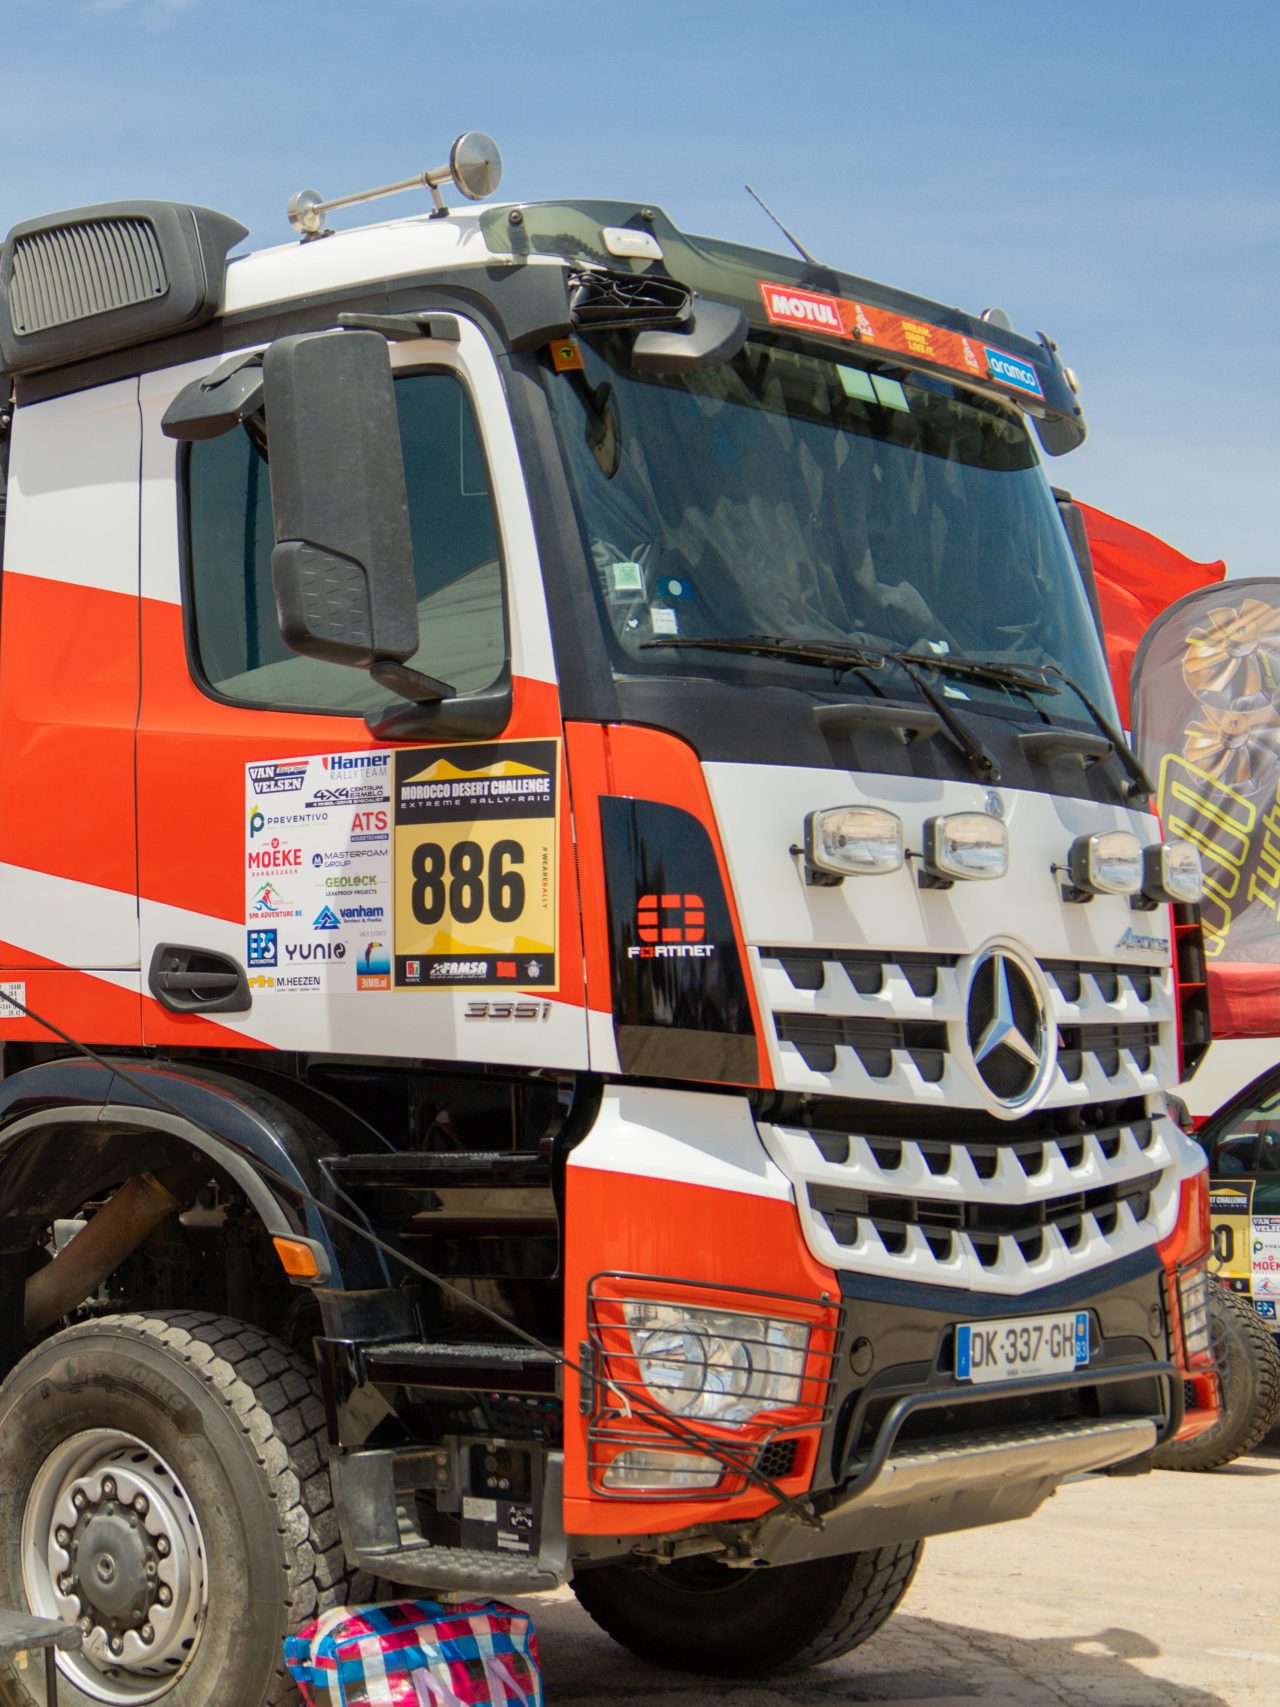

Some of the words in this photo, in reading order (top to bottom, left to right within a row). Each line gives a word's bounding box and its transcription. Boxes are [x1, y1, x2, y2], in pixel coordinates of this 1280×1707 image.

[772, 293, 838, 326] MOTUL
[990, 356, 1036, 388] aramco
[331, 755, 390, 770] Hamer
[250, 766, 276, 780] VAN
[254, 777, 302, 794] VELSEN
[350, 785, 383, 794] CENTRUM
[401, 783, 451, 801] MOROCCO
[451, 781, 490, 797] DESERT
[490, 778, 551, 795] CHALLENGE
[350, 790, 384, 799] ERMELO
[401, 799, 462, 809] EXTREME
[267, 812, 328, 825] PREVENTIVO
[351, 810, 388, 832] ATS
[248, 848, 302, 869] MOEKE
[324, 849, 389, 860] MASTERFOAM
[324, 860, 351, 869] GROUP
[411, 839, 526, 925] 886
[249, 911, 259, 920] SPA
[340, 905, 384, 919] vanham
[627, 945, 715, 958] FORTINET
[276, 975, 320, 987] M.HEEZEN
[1076, 1341, 1087, 1358] 83
